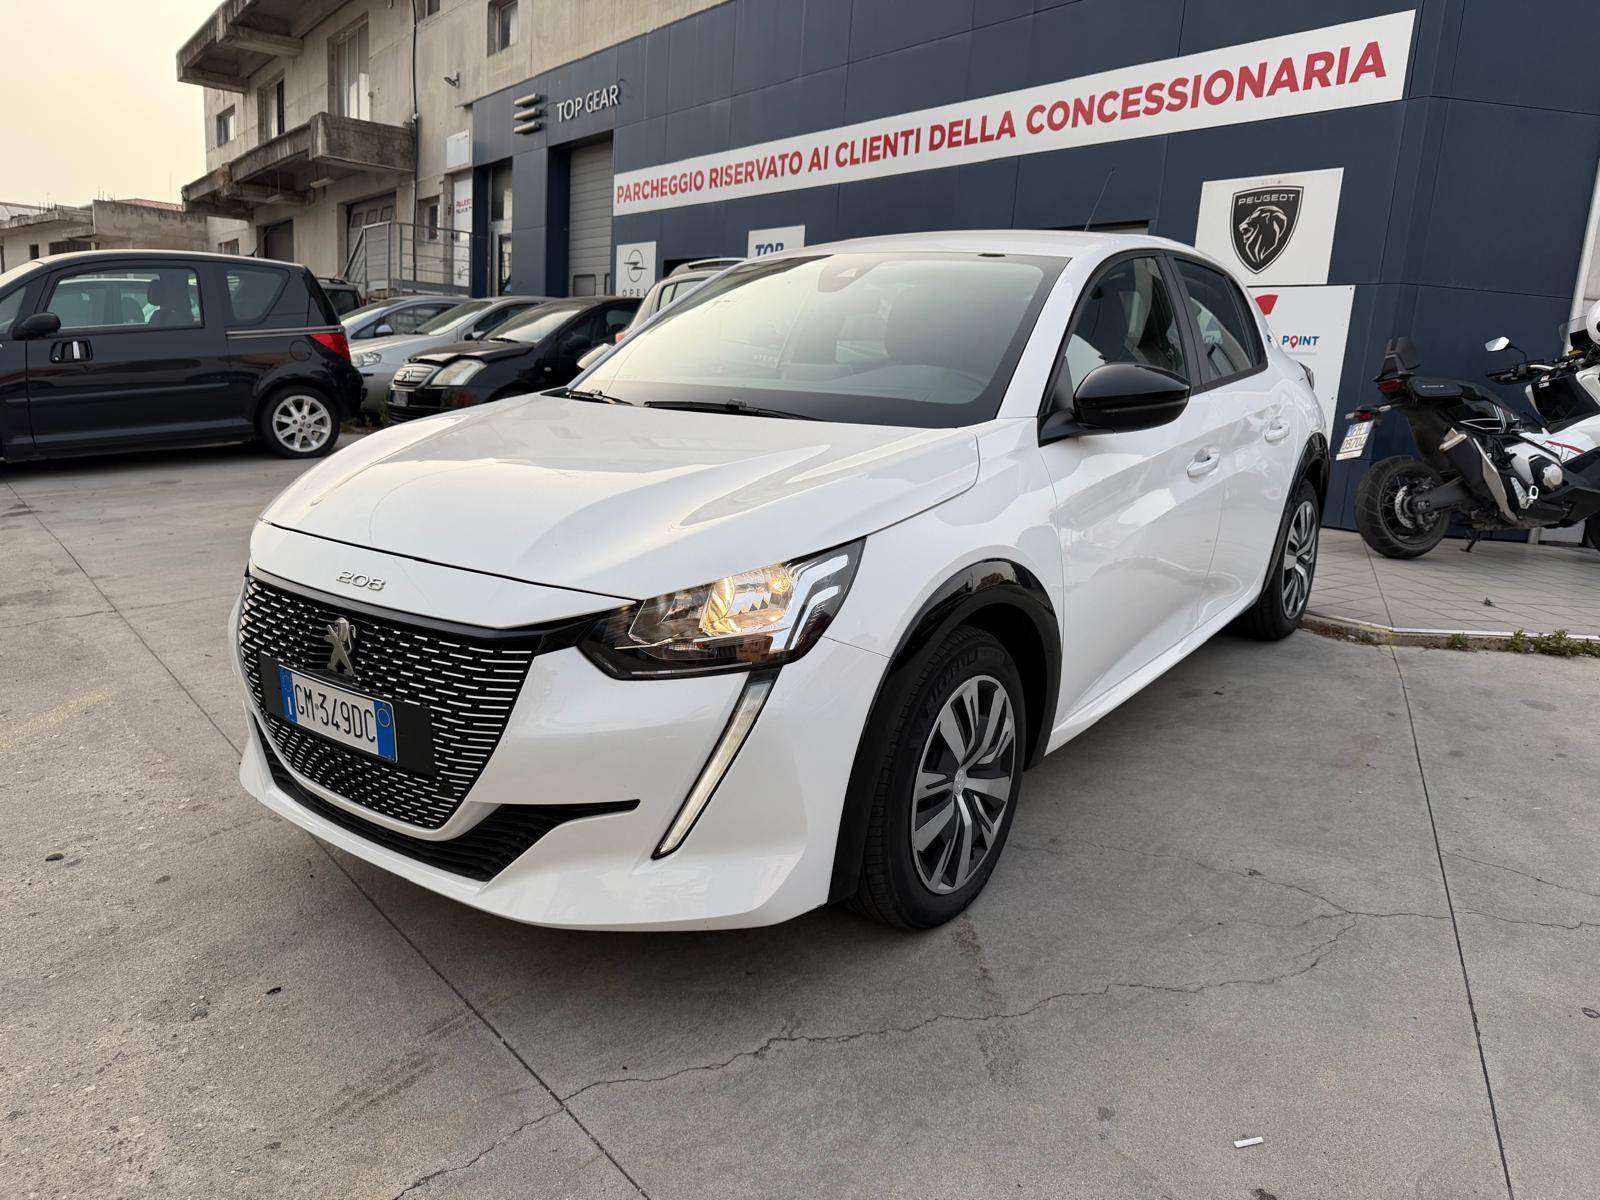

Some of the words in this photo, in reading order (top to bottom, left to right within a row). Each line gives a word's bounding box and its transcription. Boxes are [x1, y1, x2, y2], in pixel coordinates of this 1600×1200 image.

[556, 97, 583, 123] TOP
[585, 84, 619, 113] GEAR
[616, 171, 704, 204] PARCHEGGIO
[709, 149, 804, 188] RISERVATO
[806, 144, 829, 173] AI
[834, 128, 923, 168] CLIENTI
[927, 111, 1017, 152] DELLA
[1025, 40, 1388, 135] CONCESSIONARIA
[1238, 193, 1296, 206] PEUGEOT
[1281, 335, 1321, 349] POINT
[336, 570, 386, 592] 208
[294, 683, 376, 743] GM349DC
